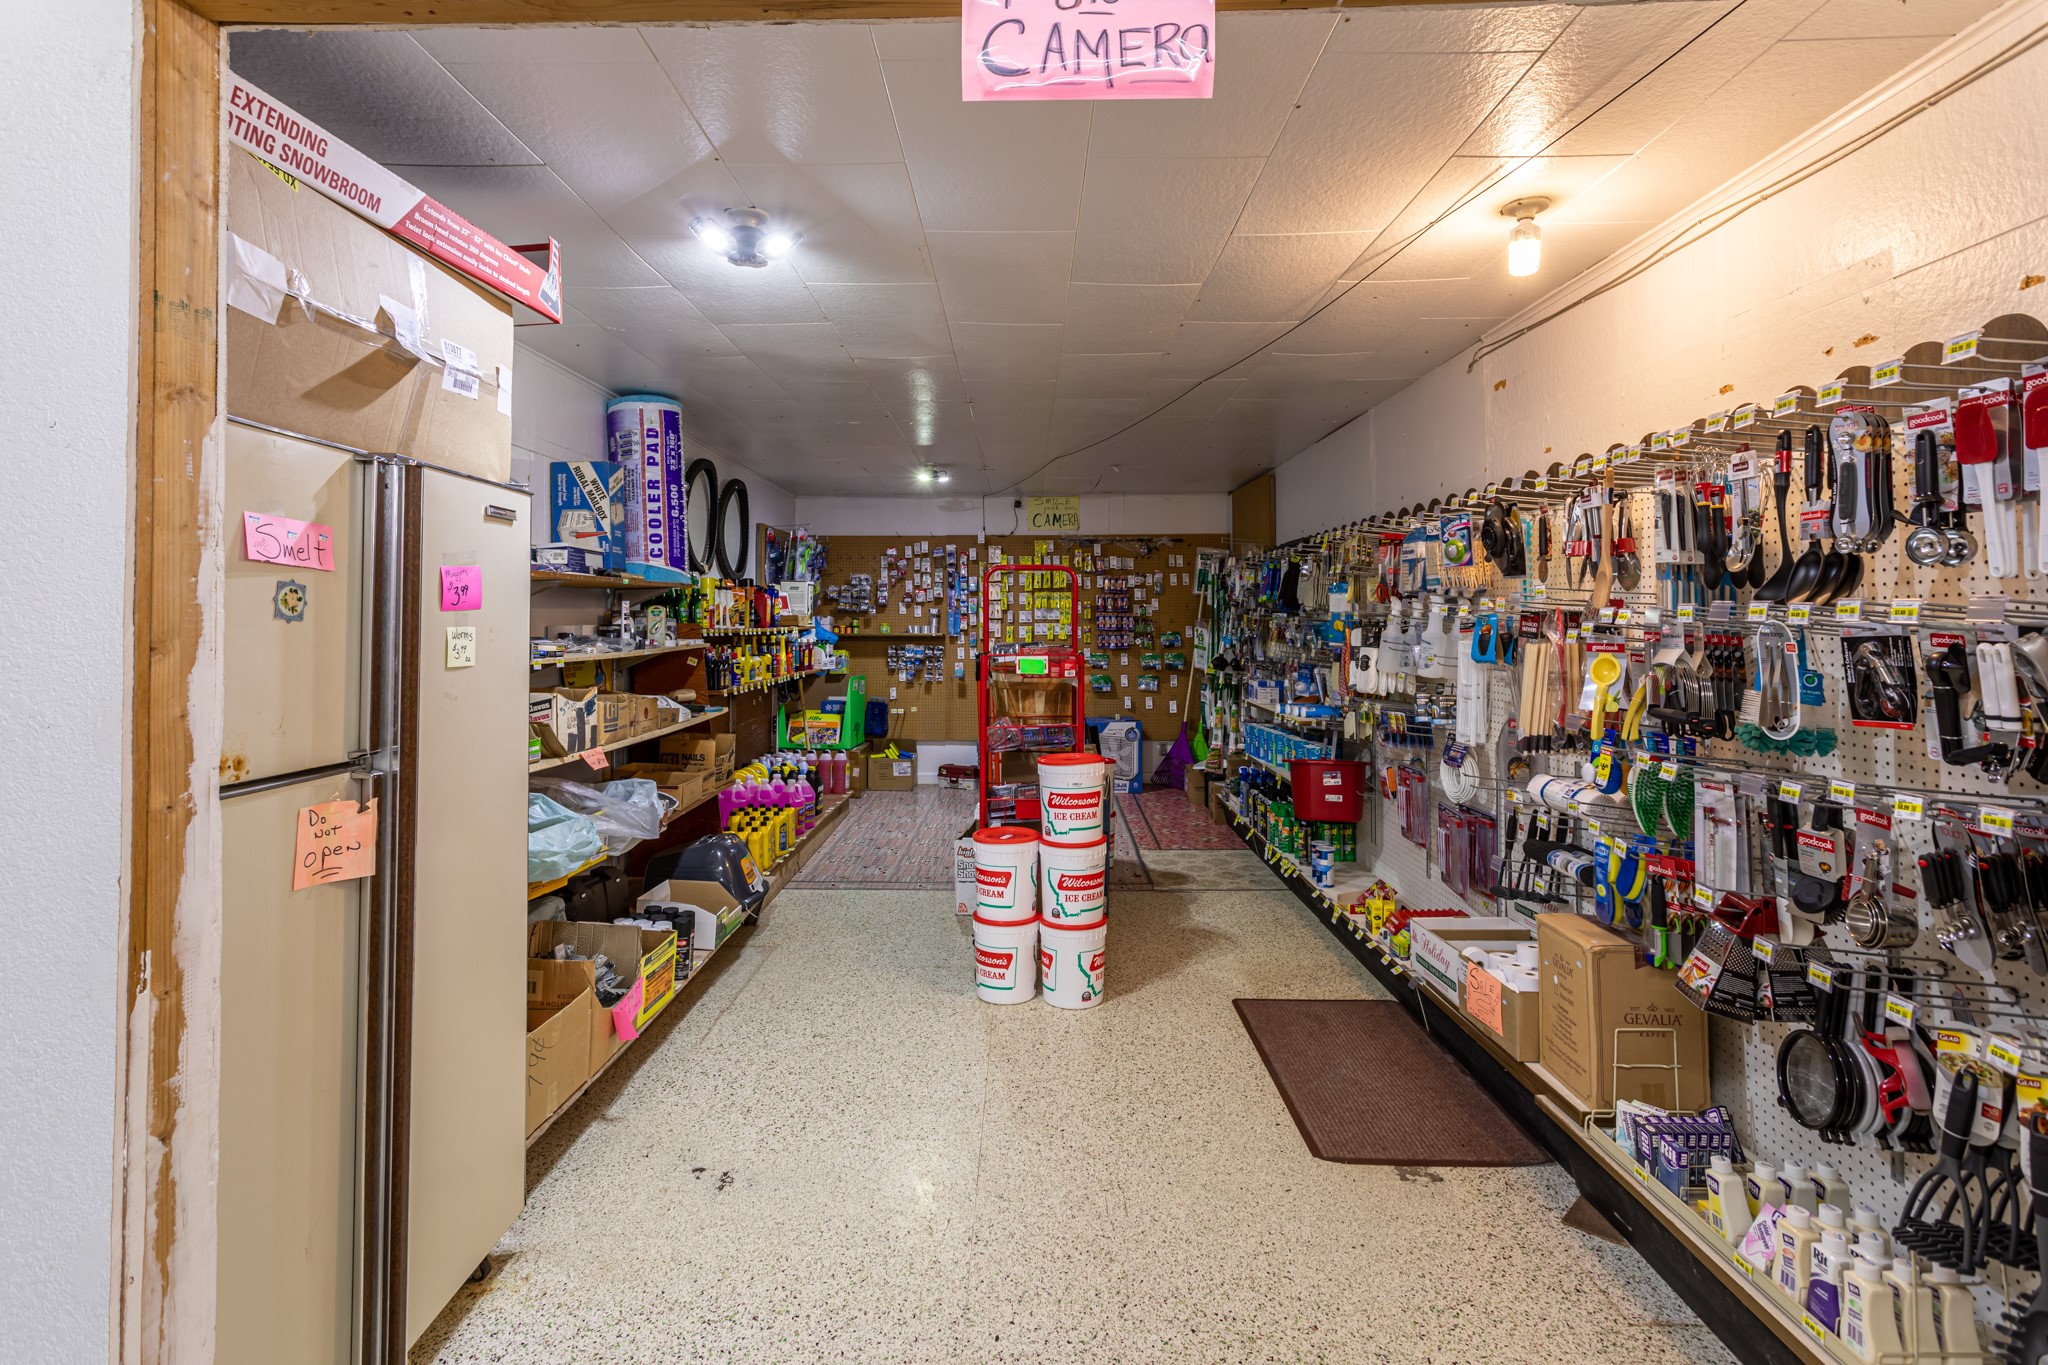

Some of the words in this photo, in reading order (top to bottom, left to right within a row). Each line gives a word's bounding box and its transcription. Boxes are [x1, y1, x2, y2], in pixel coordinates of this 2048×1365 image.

[230, 85, 328, 158] EXTENDING
[279, 143, 382, 214] SNOWBROOM
[424, 204, 446, 223] Extends
[447, 217, 460, 231] from
[483, 241, 495, 253] with
[405, 220, 422, 236] Twist
[422, 230, 435, 244] lock
[436, 237, 463, 258] extension
[463, 252, 478, 268] easily
[478, 260, 492, 275] locks
[414, 212, 434, 229] Broom
[435, 224, 449, 238] head
[449, 232, 468, 249] rotates
[479, 250, 499, 268] degrees
[1909, 411, 1946, 427] goodcook
[646, 427, 661, 467] PAD
[572, 465, 590, 490] RURAL
[586, 489, 608, 522] MAILBOX
[590, 477, 608, 502] WHITE
[670, 484, 680, 518] 6,500
[1034, 497, 1071, 505] SMILE
[647, 478, 664, 560] COOLER
[1032, 512, 1080, 530] CAMERA
[1800, 511, 1822, 521] goodcook
[255, 522, 326, 567] Smelt
[451, 630, 474, 642] Worms
[1592, 643, 1619, 652] goodcook
[529, 702, 550, 712] lavos
[681, 753, 706, 762] NAILS
[1050, 794, 1099, 806] Wilcoxson's
[308, 808, 328, 827] Do
[1054, 811, 1067, 820] ICE
[1069, 811, 1098, 821] CREAM
[1860, 811, 1888, 827] goodcook
[1798, 833, 1834, 850] goodcook
[957, 860, 975, 869] Sno
[1648, 864, 1673, 876] goodcook
[979, 888, 1005, 899] CREAM
[1065, 894, 1080, 903] ICE
[1081, 891, 1103, 902] CREAM
[1421, 932, 1451, 974] Holiday
[979, 969, 1006, 980] CREAM
[1552, 957, 1574, 978] GEVALIA
[1938, 1033, 1960, 1043] GLAD
[2017, 1079, 2041, 1088] GLAD
[1660, 1140, 1678, 1165] Rit
[1757, 1223, 1770, 1250] Remover
[1761, 1220, 1771, 1237] Color
[1812, 1246, 1829, 1267] Rit
